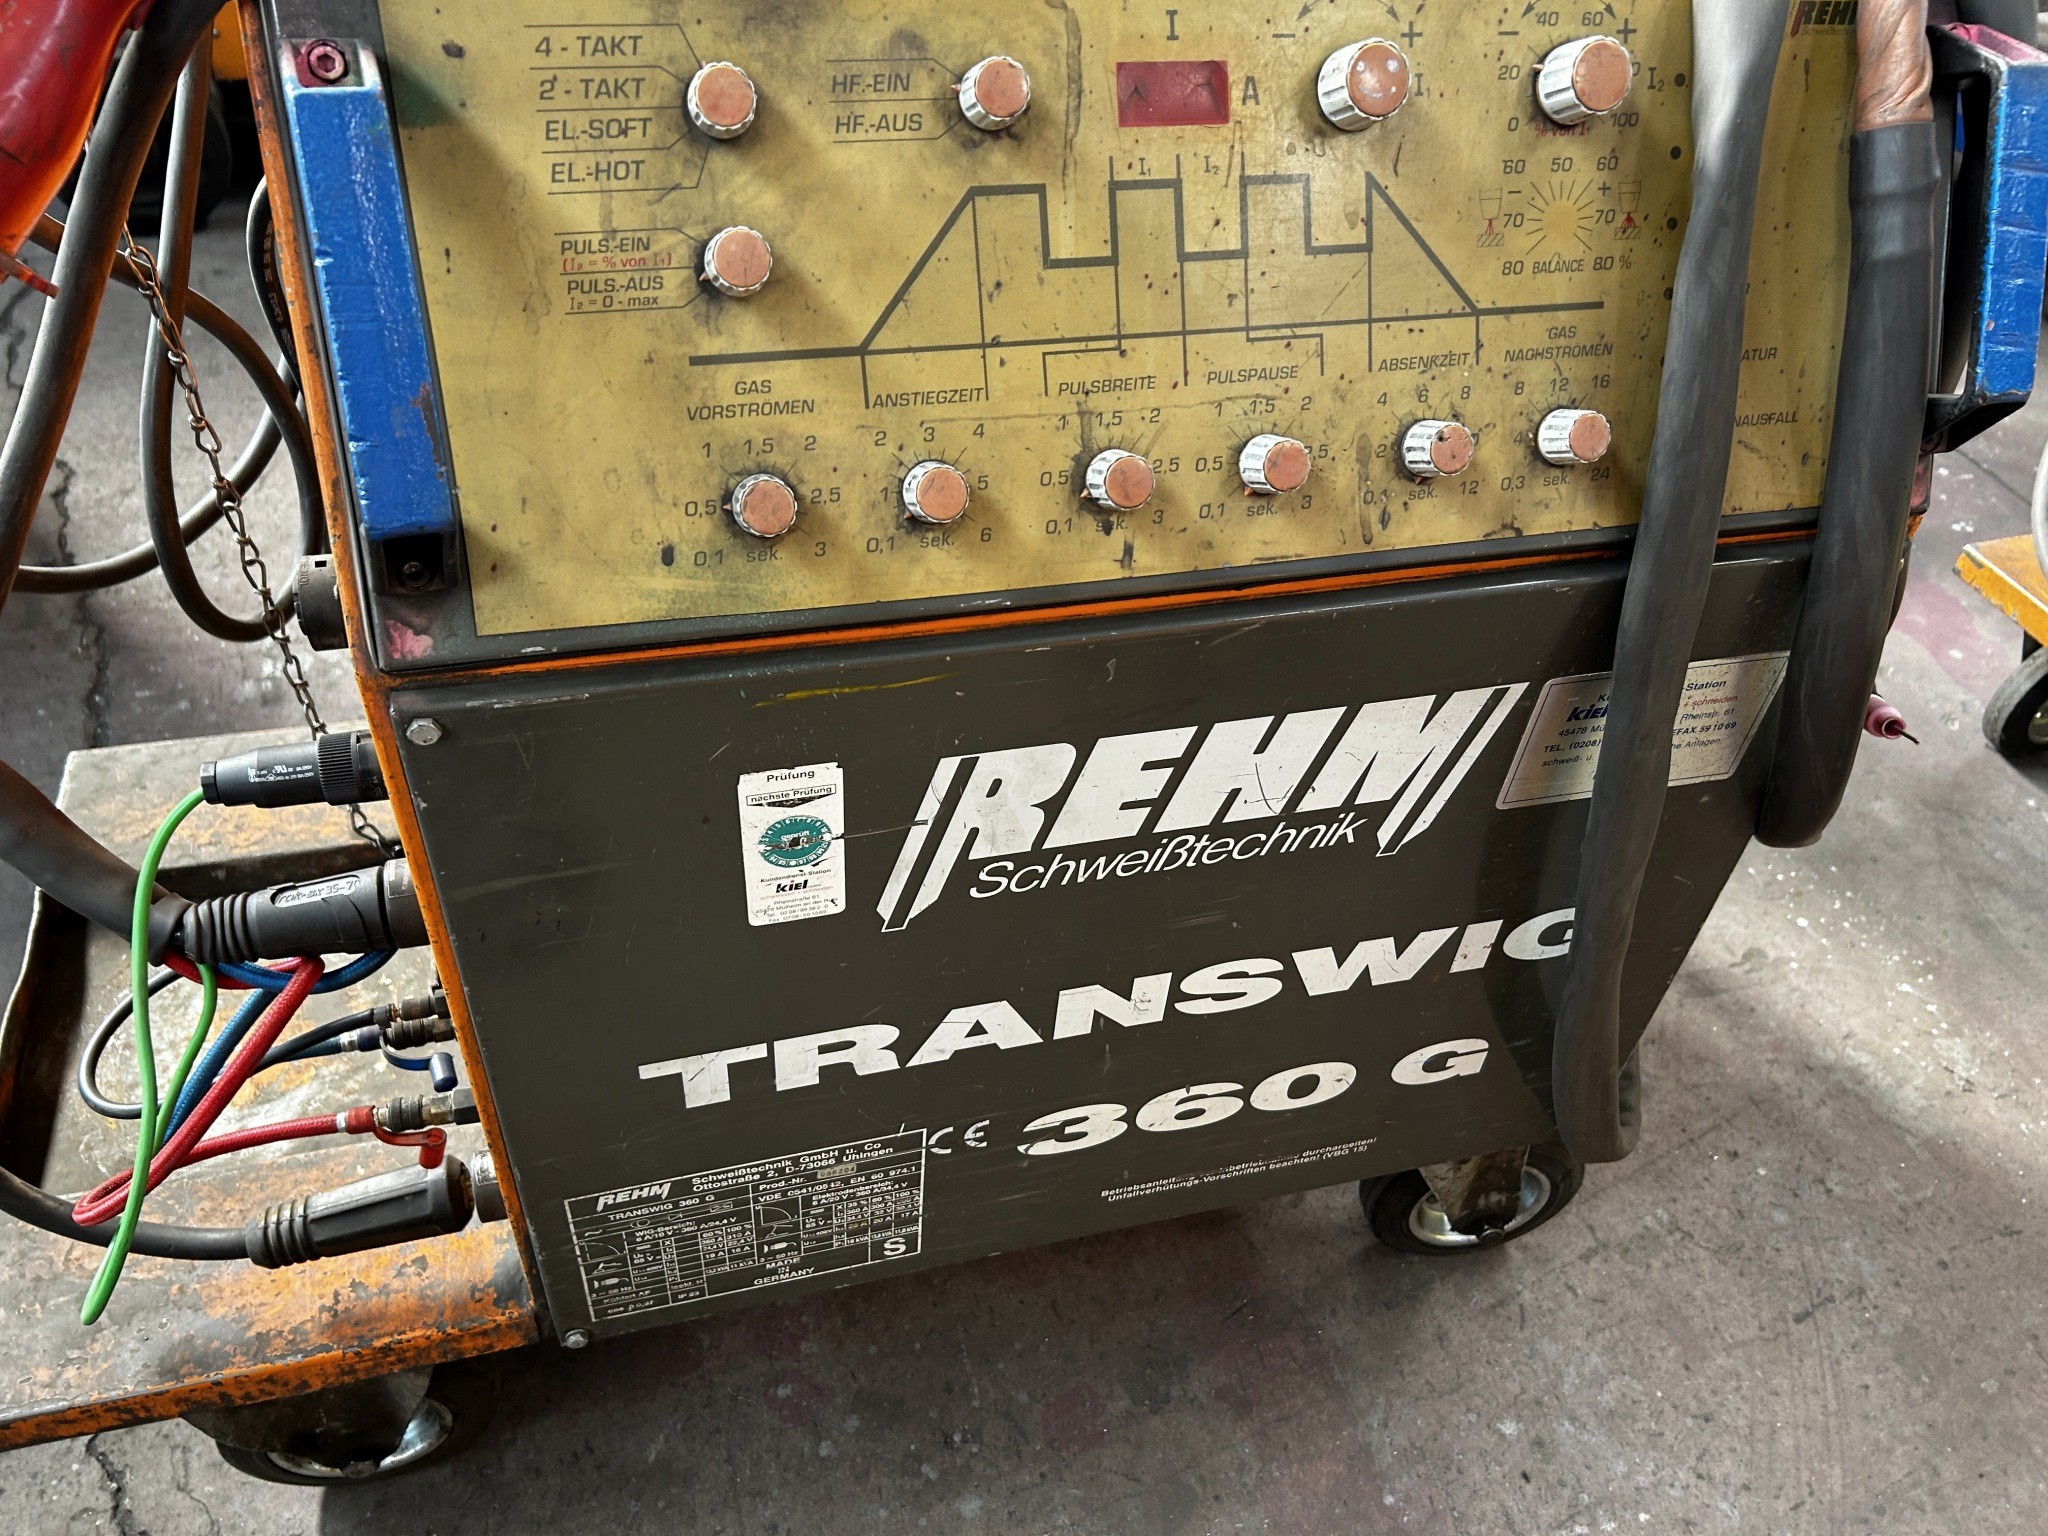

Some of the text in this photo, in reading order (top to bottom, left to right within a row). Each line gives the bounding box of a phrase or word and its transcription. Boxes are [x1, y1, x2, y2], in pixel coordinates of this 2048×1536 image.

[1536, 11, 1604, 27] 40 60
[534, 34, 643, 58] 4 TAKT
[1497, 64, 1521, 80] 20
[538, 77, 646, 101] 2 TAKT
[831, 73, 911, 94] HF.-EIN
[1242, 75, 1261, 106] A
[544, 117, 653, 142] EL.-SOFT
[834, 112, 924, 134] HF.-AUS
[1507, 112, 1639, 132] 0 100
[550, 159, 647, 184] EL.-HOT
[1502, 155, 1619, 175] 60 50 60
[1502, 212, 1525, 229] 70
[1595, 208, 1617, 225] 70
[560, 236, 651, 256] PULS.-EIN
[620, 256, 647, 269] von
[1501, 259, 1525, 276] 80
[1531, 258, 1586, 275] BALANCE
[1592, 255, 1615, 272] 80
[567, 275, 665, 296] PULS.-AUS
[627, 295, 660, 308] max
[1547, 325, 1578, 340] GAS
[1377, 352, 1471, 373] ABSENKZEIT
[1057, 375, 1158, 396] PULSBREITE
[1206, 365, 1300, 386] PULSPAUSE
[1513, 373, 1611, 396] 8 12 16
[734, 379, 773, 396] GAS
[872, 387, 985, 409] ANSTIEGZEIT
[1376, 384, 1472, 407] 4 6 8
[686, 398, 816, 422] VORSTRÖMEN
[1213, 395, 1313, 418] 1 1,5 2
[1058, 407, 1162, 431] 1 1,5 2
[874, 422, 986, 447] 2 3 4
[1512, 429, 1524, 445] 4
[701, 435, 817, 458] 1 1,5 2
[1375, 442, 1388, 459] 2
[1152, 456, 1180, 475] 2,5
[1195, 455, 1224, 473] 0,5
[976, 475, 989, 491] 5
[1039, 469, 1070, 488] 0,5
[1500, 466, 1611, 492] 0,3 sek. 24
[810, 487, 842, 505] 2,5
[880, 486, 890, 502] 1
[1407, 484, 1439, 501] sek.
[1459, 479, 1480, 496] 12
[684, 499, 718, 519] 0,5
[1199, 494, 1313, 520] 0,1 sek. 3
[1045, 509, 1165, 536] 0,1 sk. 3
[866, 526, 993, 555] 0,1 sek. 6
[746, 546, 783, 563] sek.
[814, 541, 827, 558] 3
[1723, 707, 1735, 716] 61
[1557, 724, 1606, 737] 45478 Mü
[1543, 744, 1565, 753] TEL.
[766, 770, 815, 783] Prüfung
[793, 786, 832, 797] Prüfung
[876, 681, 1531, 933] REHM
[968, 811, 1369, 899] Schweißtechnik
[637, 907, 1576, 1110] TRANSWIG
[1015, 1036, 1490, 1157] 360 G
[691, 1160, 793, 1186] Schweißtechnik
[799, 1149, 839, 1163] GmbH
[864, 1142, 882, 1151] Co
[785, 1158, 836, 1174] D-73066
[842, 1146, 894, 1163] Uhingen
[1269, 1154, 1320, 1170] beachten!
[757, 1192, 782, 1203] VDE
[850, 1175, 866, 1184] EN
[758, 1176, 808, 1191] Prod.-Nr.
[596, 1182, 672, 1213] REHM
[607, 1193, 715, 1222] TRANSWIG 360 G
[883, 1237, 907, 1256] S
[753, 1266, 815, 1285] GERMANY
